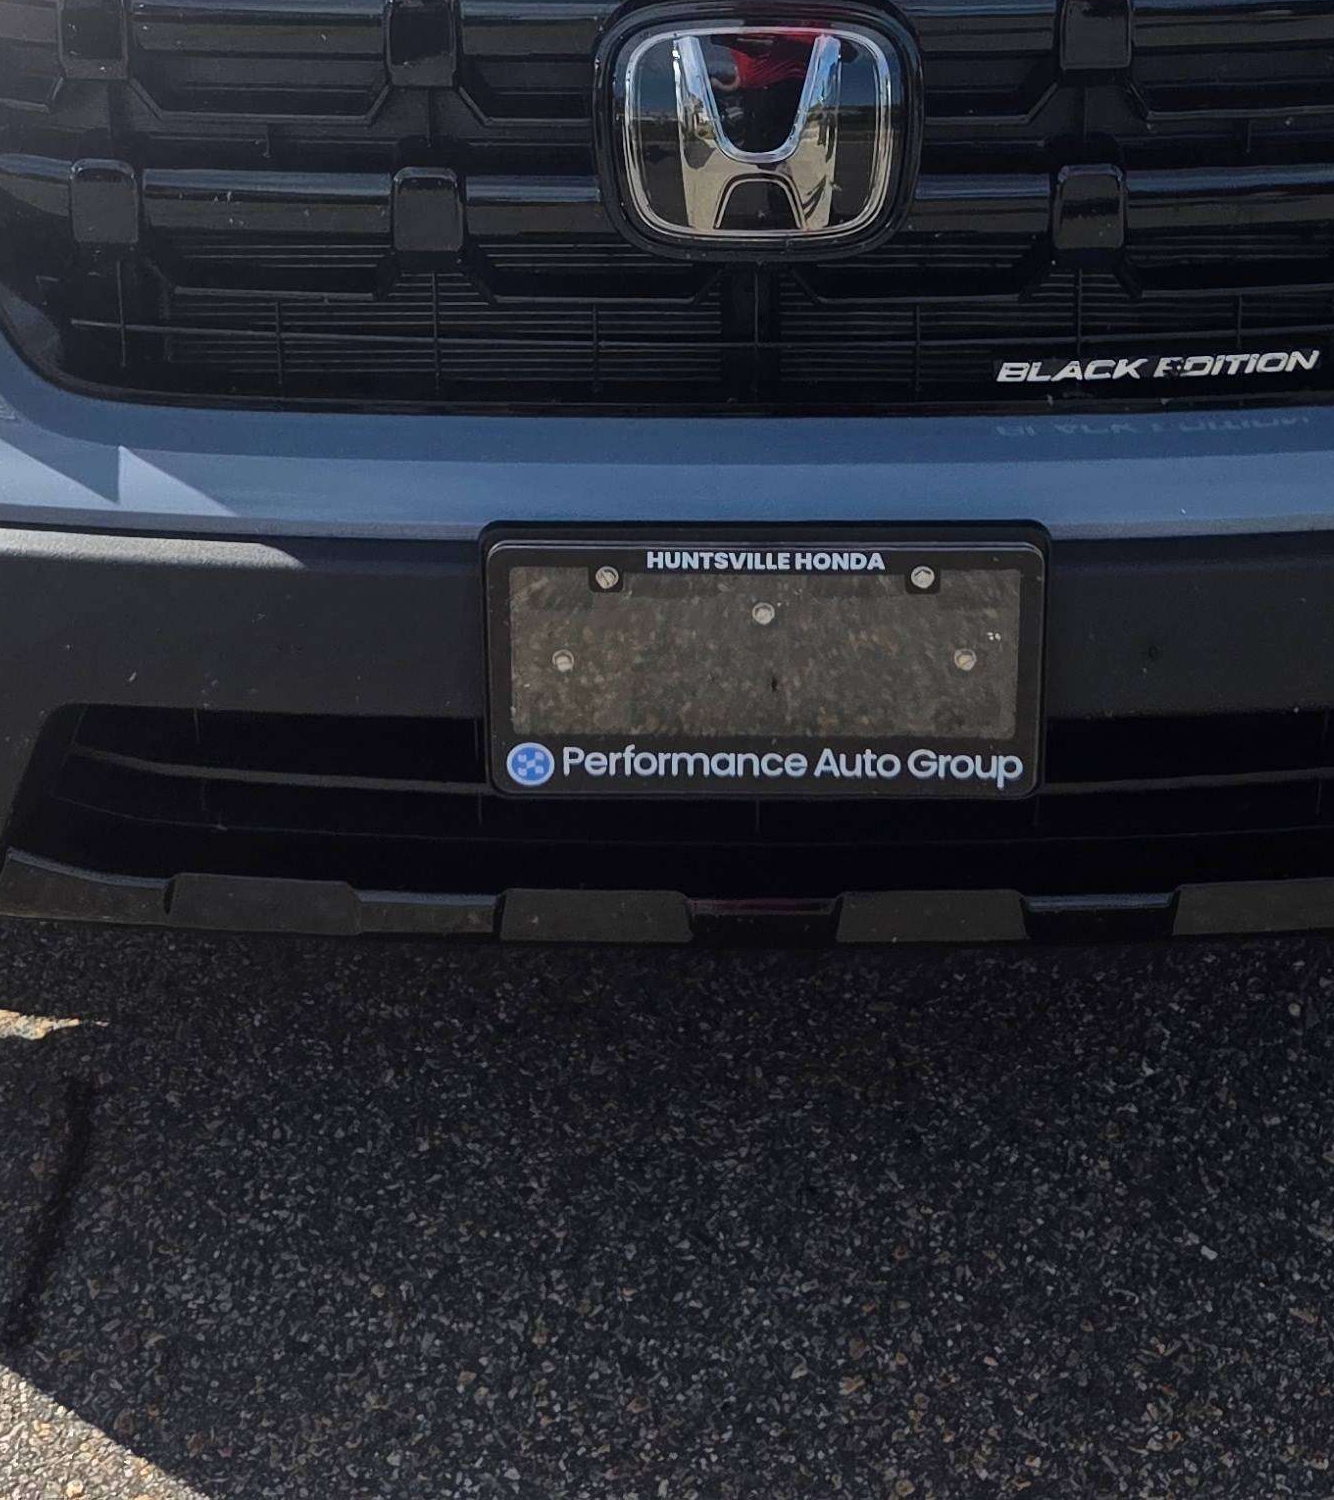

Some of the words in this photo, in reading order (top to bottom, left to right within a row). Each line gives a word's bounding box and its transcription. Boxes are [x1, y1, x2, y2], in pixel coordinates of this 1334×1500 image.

[996, 358, 1150, 382] BLACK
[1153, 350, 1320, 377] EDITION
[646, 551, 791, 570] HUNTSVILLE
[794, 552, 886, 570] HONDA
[562, 744, 808, 779] Performance
[813, 748, 902, 780] Auto
[906, 748, 1024, 790] Group
